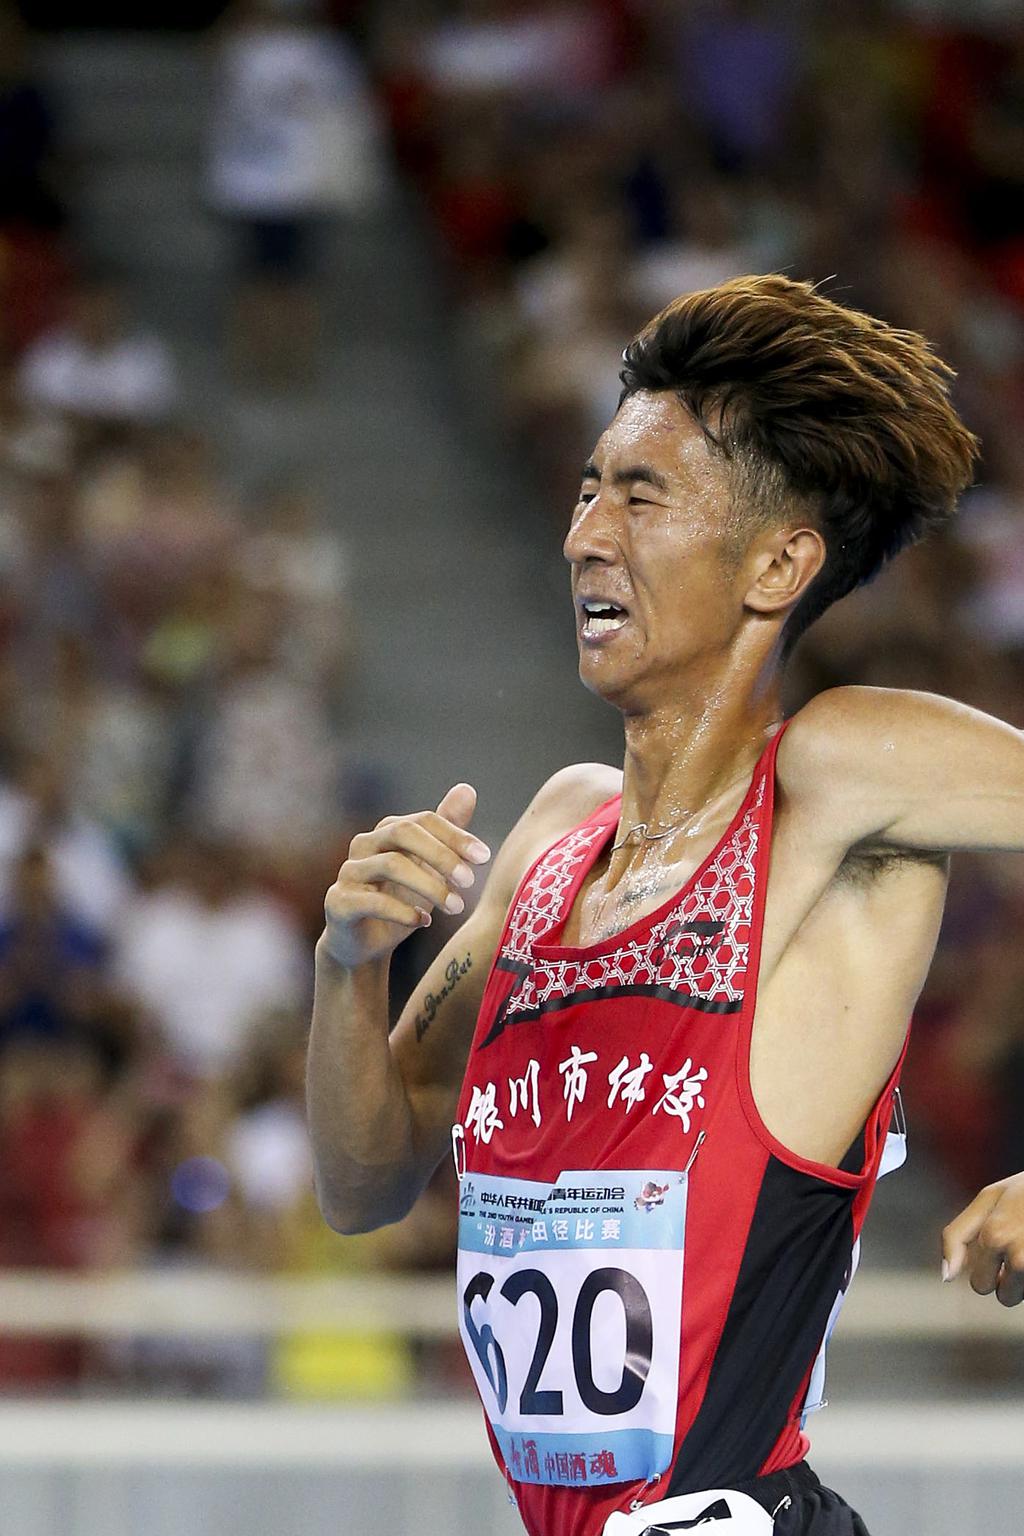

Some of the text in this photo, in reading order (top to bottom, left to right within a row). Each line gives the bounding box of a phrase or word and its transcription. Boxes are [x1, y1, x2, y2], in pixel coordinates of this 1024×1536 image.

[498, 1213, 514, 1222] YOUTH
[514, 1215, 534, 1224] GAMES
[463, 1267, 653, 1416] 620
